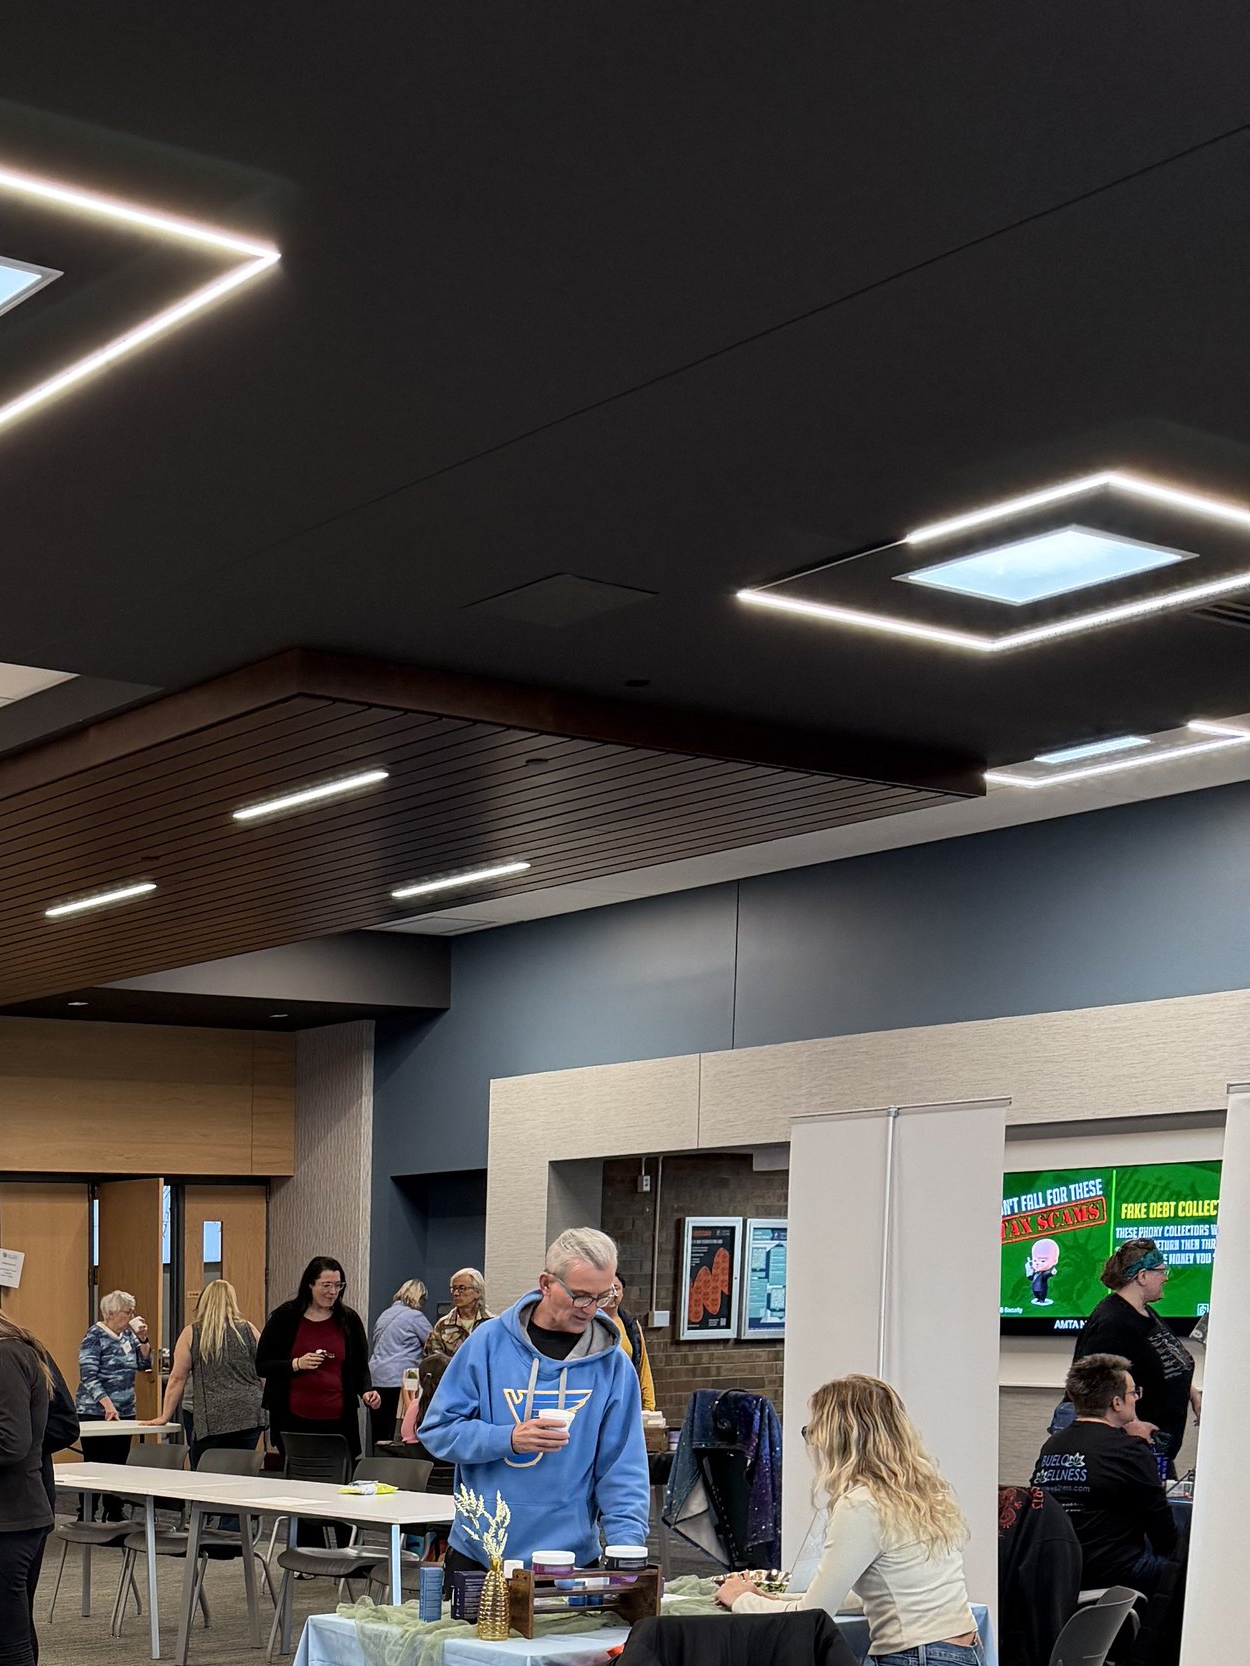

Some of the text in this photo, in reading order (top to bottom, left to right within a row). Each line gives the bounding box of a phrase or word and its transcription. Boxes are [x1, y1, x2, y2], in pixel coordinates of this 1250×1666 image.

[1020, 1191, 1045, 1212] FALL
[1046, 1186, 1068, 1206] FOR
[1069, 1178, 1103, 1202] THESE
[1036, 1203, 1100, 1232] SCAMS
[1121, 1202, 1148, 1219] FAKE
[1149, 1201, 1176, 1218] DEBT
[1116, 1226, 1138, 1239] THESE
[1138, 1225, 1163, 1238] PHONY
[1164, 1224, 1209, 1237] COLLECTORS
[1054, 1319, 1079, 1330] AMTA
